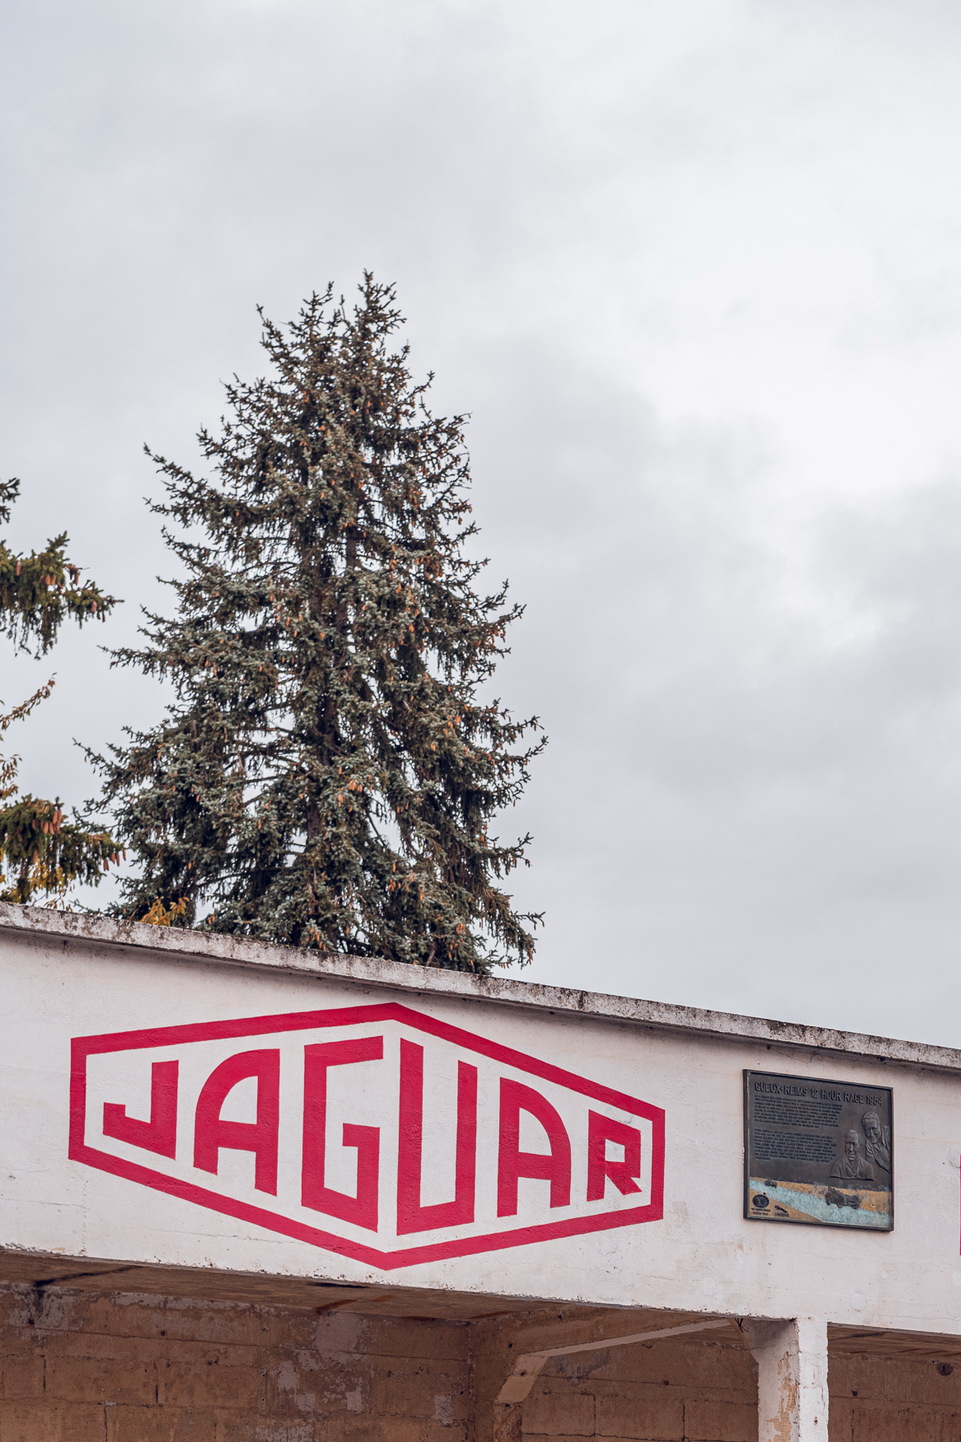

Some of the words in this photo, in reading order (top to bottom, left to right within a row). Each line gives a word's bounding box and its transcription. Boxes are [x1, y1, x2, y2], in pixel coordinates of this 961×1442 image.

[102, 1034, 642, 1236] JAGUAR
[810, 1088, 818, 1100] 12
[820, 1090, 842, 1102] HOUR
[844, 1093, 865, 1105] RACE
